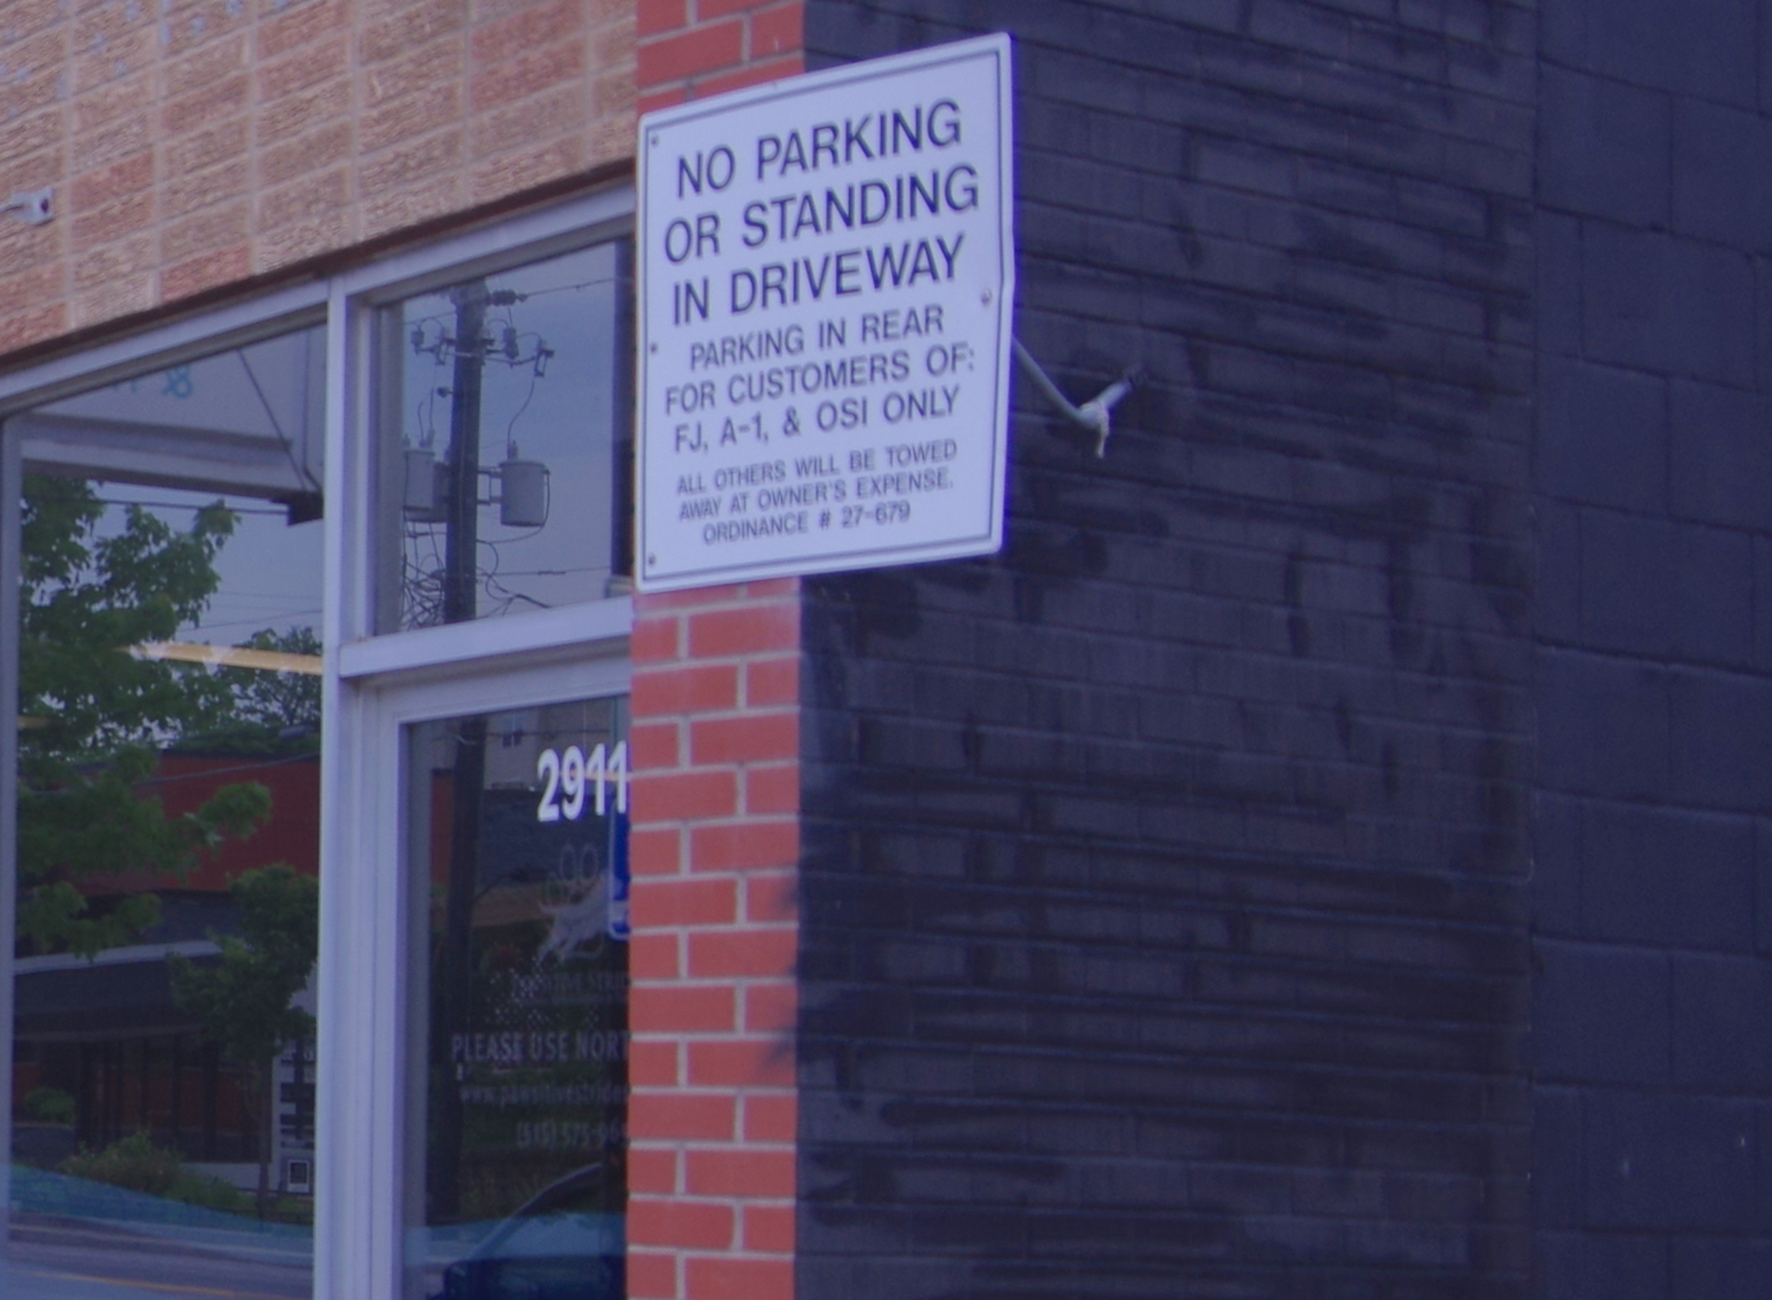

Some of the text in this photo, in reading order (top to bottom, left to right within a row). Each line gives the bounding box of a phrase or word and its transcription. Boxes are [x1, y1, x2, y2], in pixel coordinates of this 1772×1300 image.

[678, 98, 962, 198] NO PARKING
[664, 163, 979, 265] OR STANDING
[673, 234, 966, 326] IN DRIVEWAY
[690, 305, 944, 371] PARKING IN REAR
[666, 384, 717, 415] FOR
[728, 349, 910, 404] CUSTOMERS
[675, 424, 709, 456] FJ,
[783, 407, 801, 437] &
[816, 398, 868, 431] OSI
[883, 385, 962, 422] ONLY
[678, 439, 957, 496] ALL OTHERS WILL BE TOWED
[680, 498, 723, 522] AWAY
[731, 493, 750, 514] AT
[759, 481, 846, 510] OWNER'S
[703, 501, 910, 546] ORDINANCE # 27-679
[537, 739, 627, 822] 2911
[451, 1031, 523, 1063] PLEASE
[529, 1030, 569, 1061] USE
